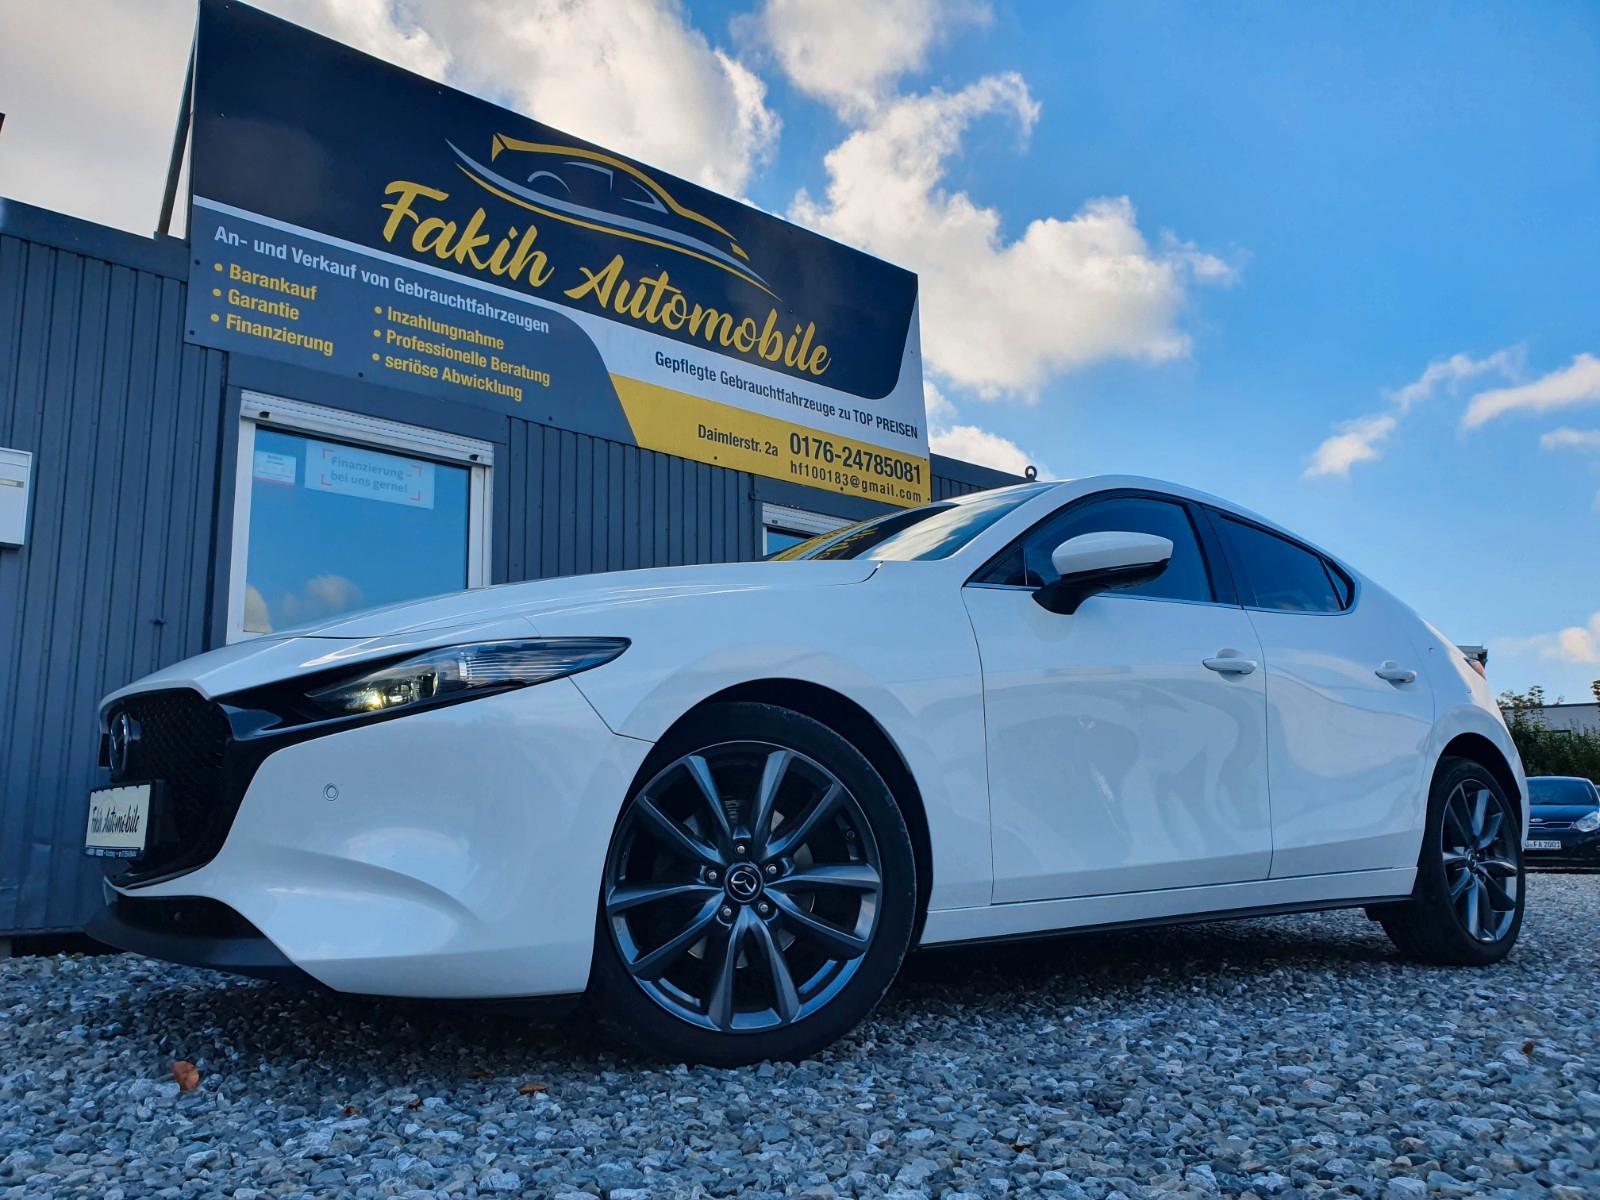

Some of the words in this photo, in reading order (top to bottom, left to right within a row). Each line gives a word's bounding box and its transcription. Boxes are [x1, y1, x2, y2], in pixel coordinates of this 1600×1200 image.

[214, 225, 248, 246] An-
[254, 239, 287, 260] und
[291, 246, 357, 279] Verkauf
[361, 268, 390, 289] von
[394, 277, 550, 334] Gebrauchtfahrzeugen
[229, 263, 318, 301] Barankauf
[380, 180, 555, 287] Fakih
[564, 254, 831, 376] Automobile
[228, 288, 300, 320] Garantie
[226, 313, 334, 356] Finanzierung
[387, 306, 504, 350] Inzahlungnahme
[385, 355, 439, 380] seriöse
[441, 367, 523, 401] Abwicklung
[386, 330, 487, 369] Professionelle
[490, 357, 551, 387] Beratung
[655, 351, 717, 382] Gepflegte
[720, 371, 836, 417] Gebrauchtfahrzeuge
[838, 407, 851, 420] zu
[853, 409, 874, 426] TOP
[876, 415, 919, 439] PREISEN
[698, 424, 763, 453] Daimlerstr.
[764, 442, 779, 457] 2a
[789, 432, 921, 485] 0176-24785081
[330, 470, 349, 484] bei
[351, 474, 371, 488] uns
[373, 478, 408, 493] gerne!
[331, 456, 404, 480] Finanzierung
[790, 460, 922, 503] hf100183@gmail.com
